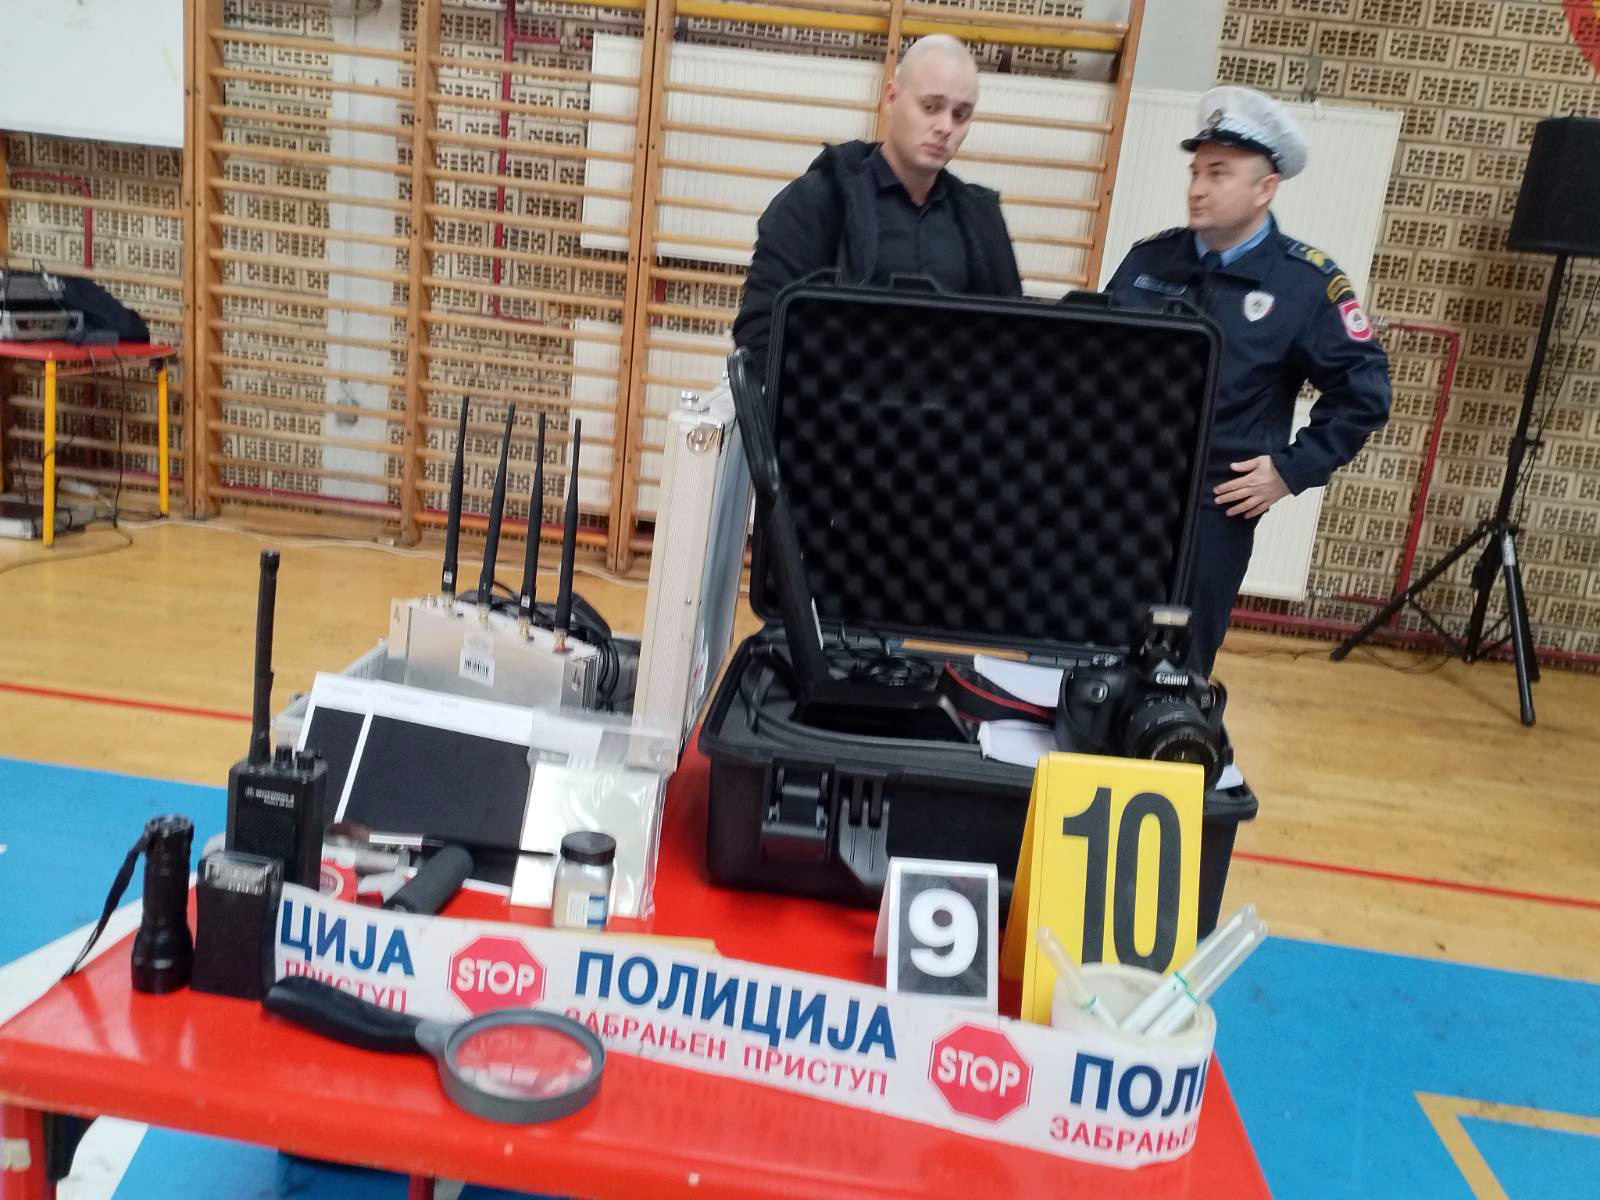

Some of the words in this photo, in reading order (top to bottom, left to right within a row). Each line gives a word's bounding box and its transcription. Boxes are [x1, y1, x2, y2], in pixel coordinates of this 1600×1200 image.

[1155, 671, 1189, 686] Canon
[1062, 786, 1182, 974] 10
[280, 899, 415, 977] ЦИЈА
[908, 887, 979, 978] 9
[456, 957, 536, 997] STOP
[575, 950, 898, 1061] ПОЛИЦИЈА
[743, 1045, 888, 1096] ПРИСТУП
[937, 1045, 1021, 1097] STOP
[1070, 1052, 1207, 1118] ПОЛ
[1050, 1115, 1196, 1154] ЗАБРАЊЕ
